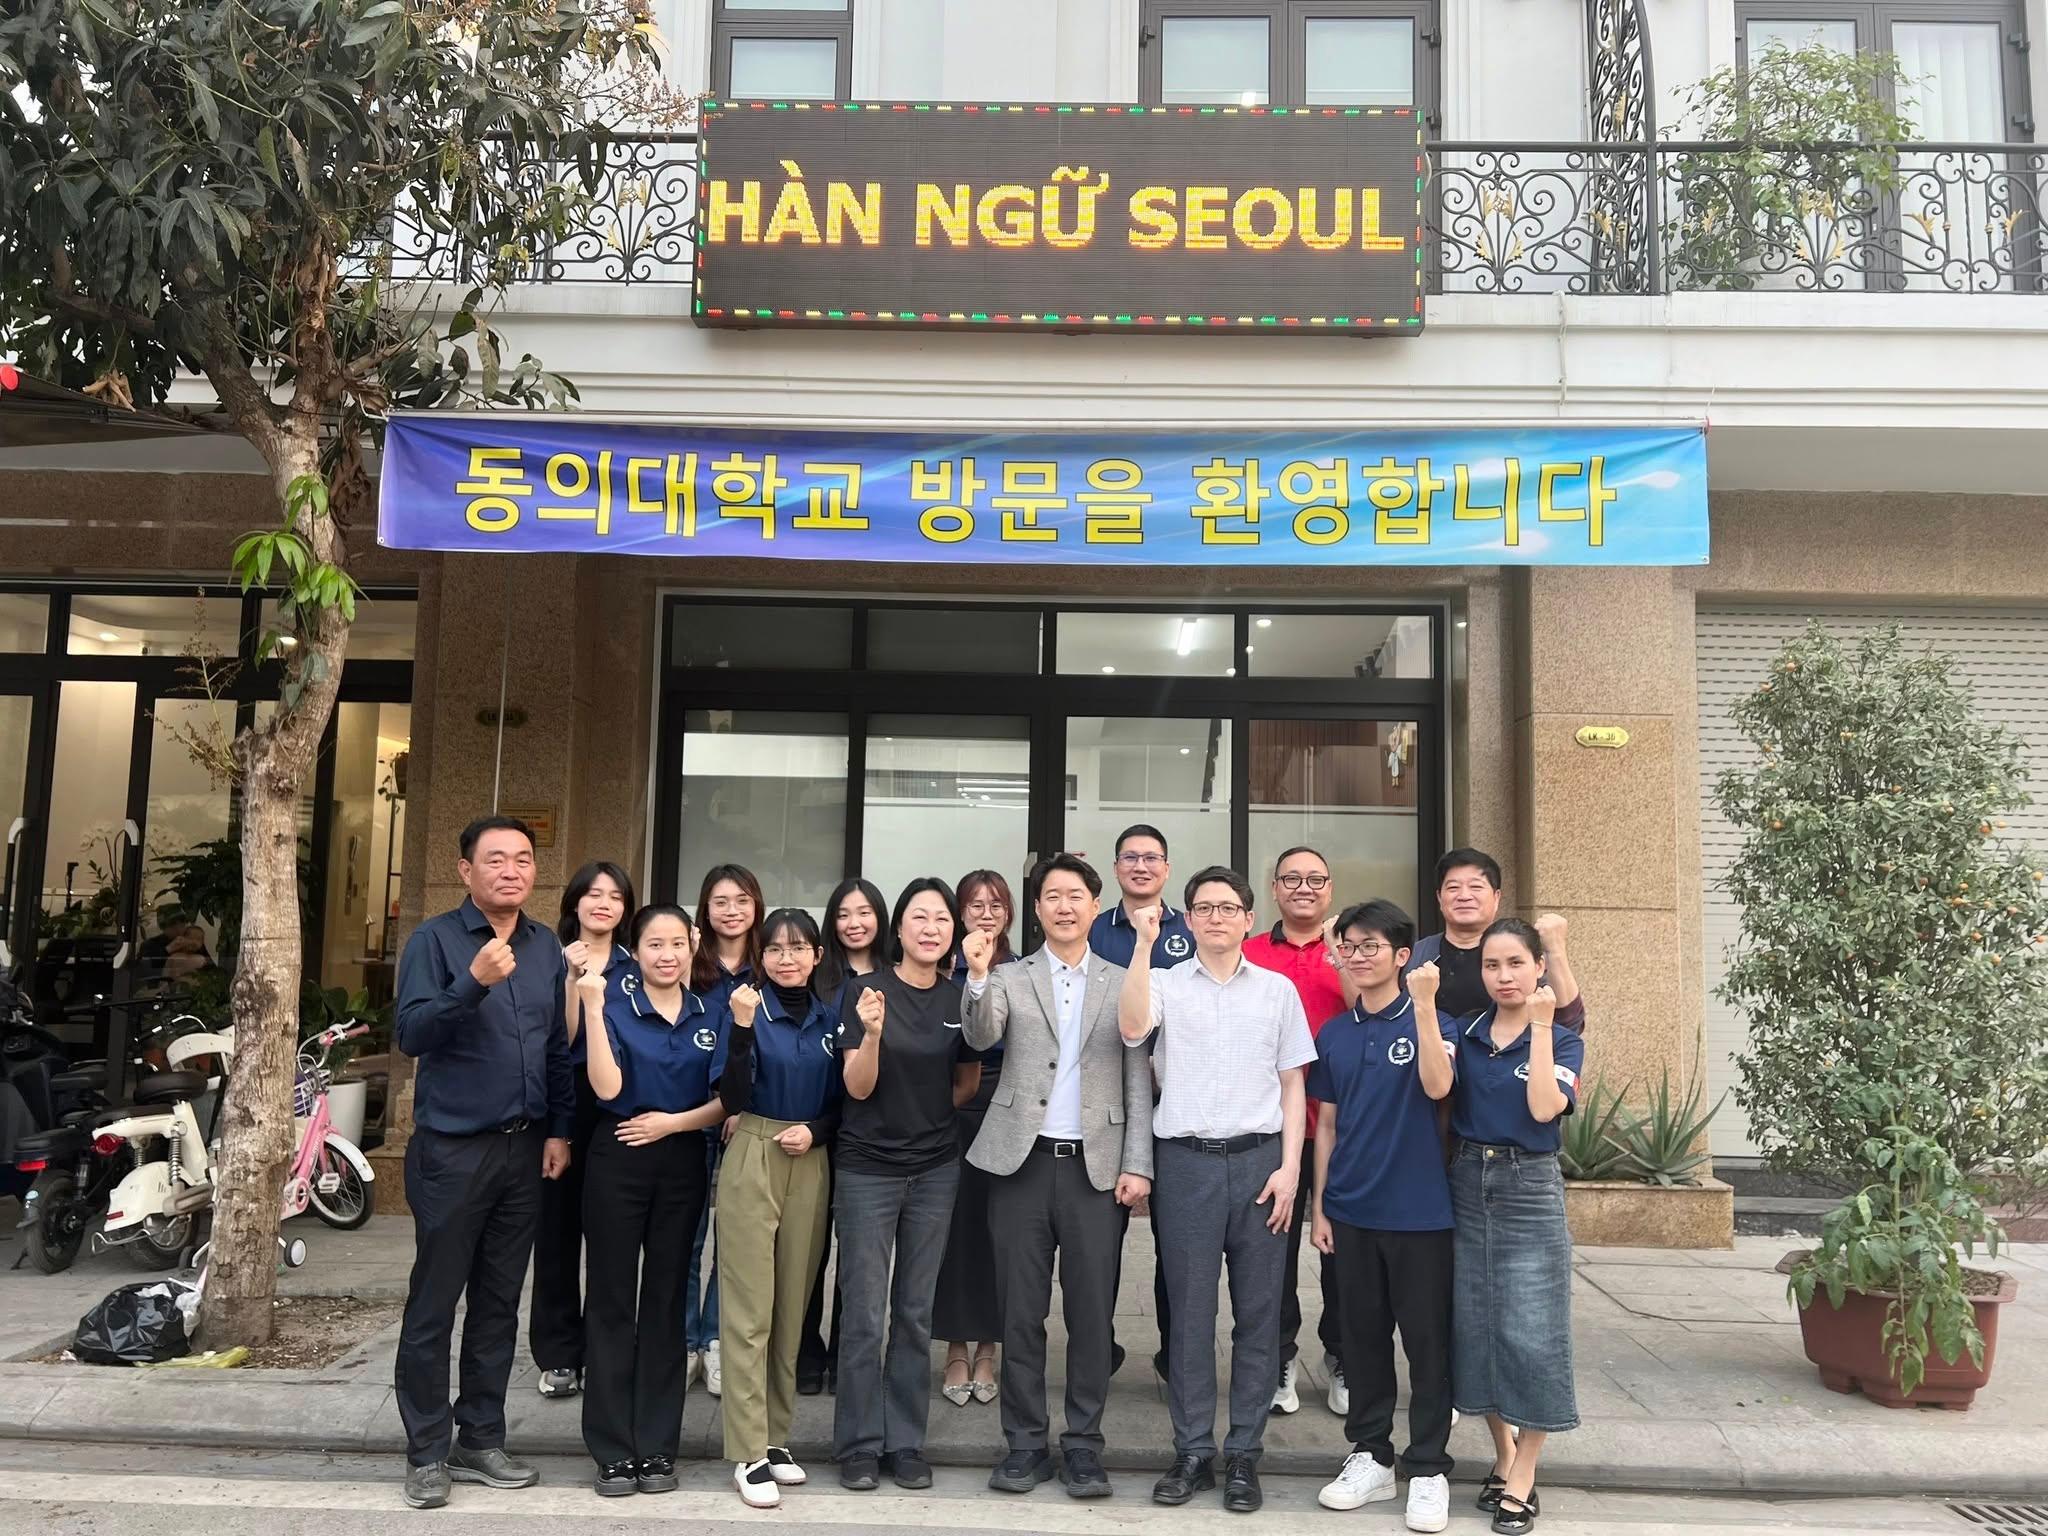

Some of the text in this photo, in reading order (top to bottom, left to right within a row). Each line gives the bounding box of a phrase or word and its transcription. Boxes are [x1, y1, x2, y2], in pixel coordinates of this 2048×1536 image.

[708, 160, 1405, 251] HÀN NGỮ SEOUL
[455, 446, 1618, 548] 동의대학교 방문을 환영합니다
